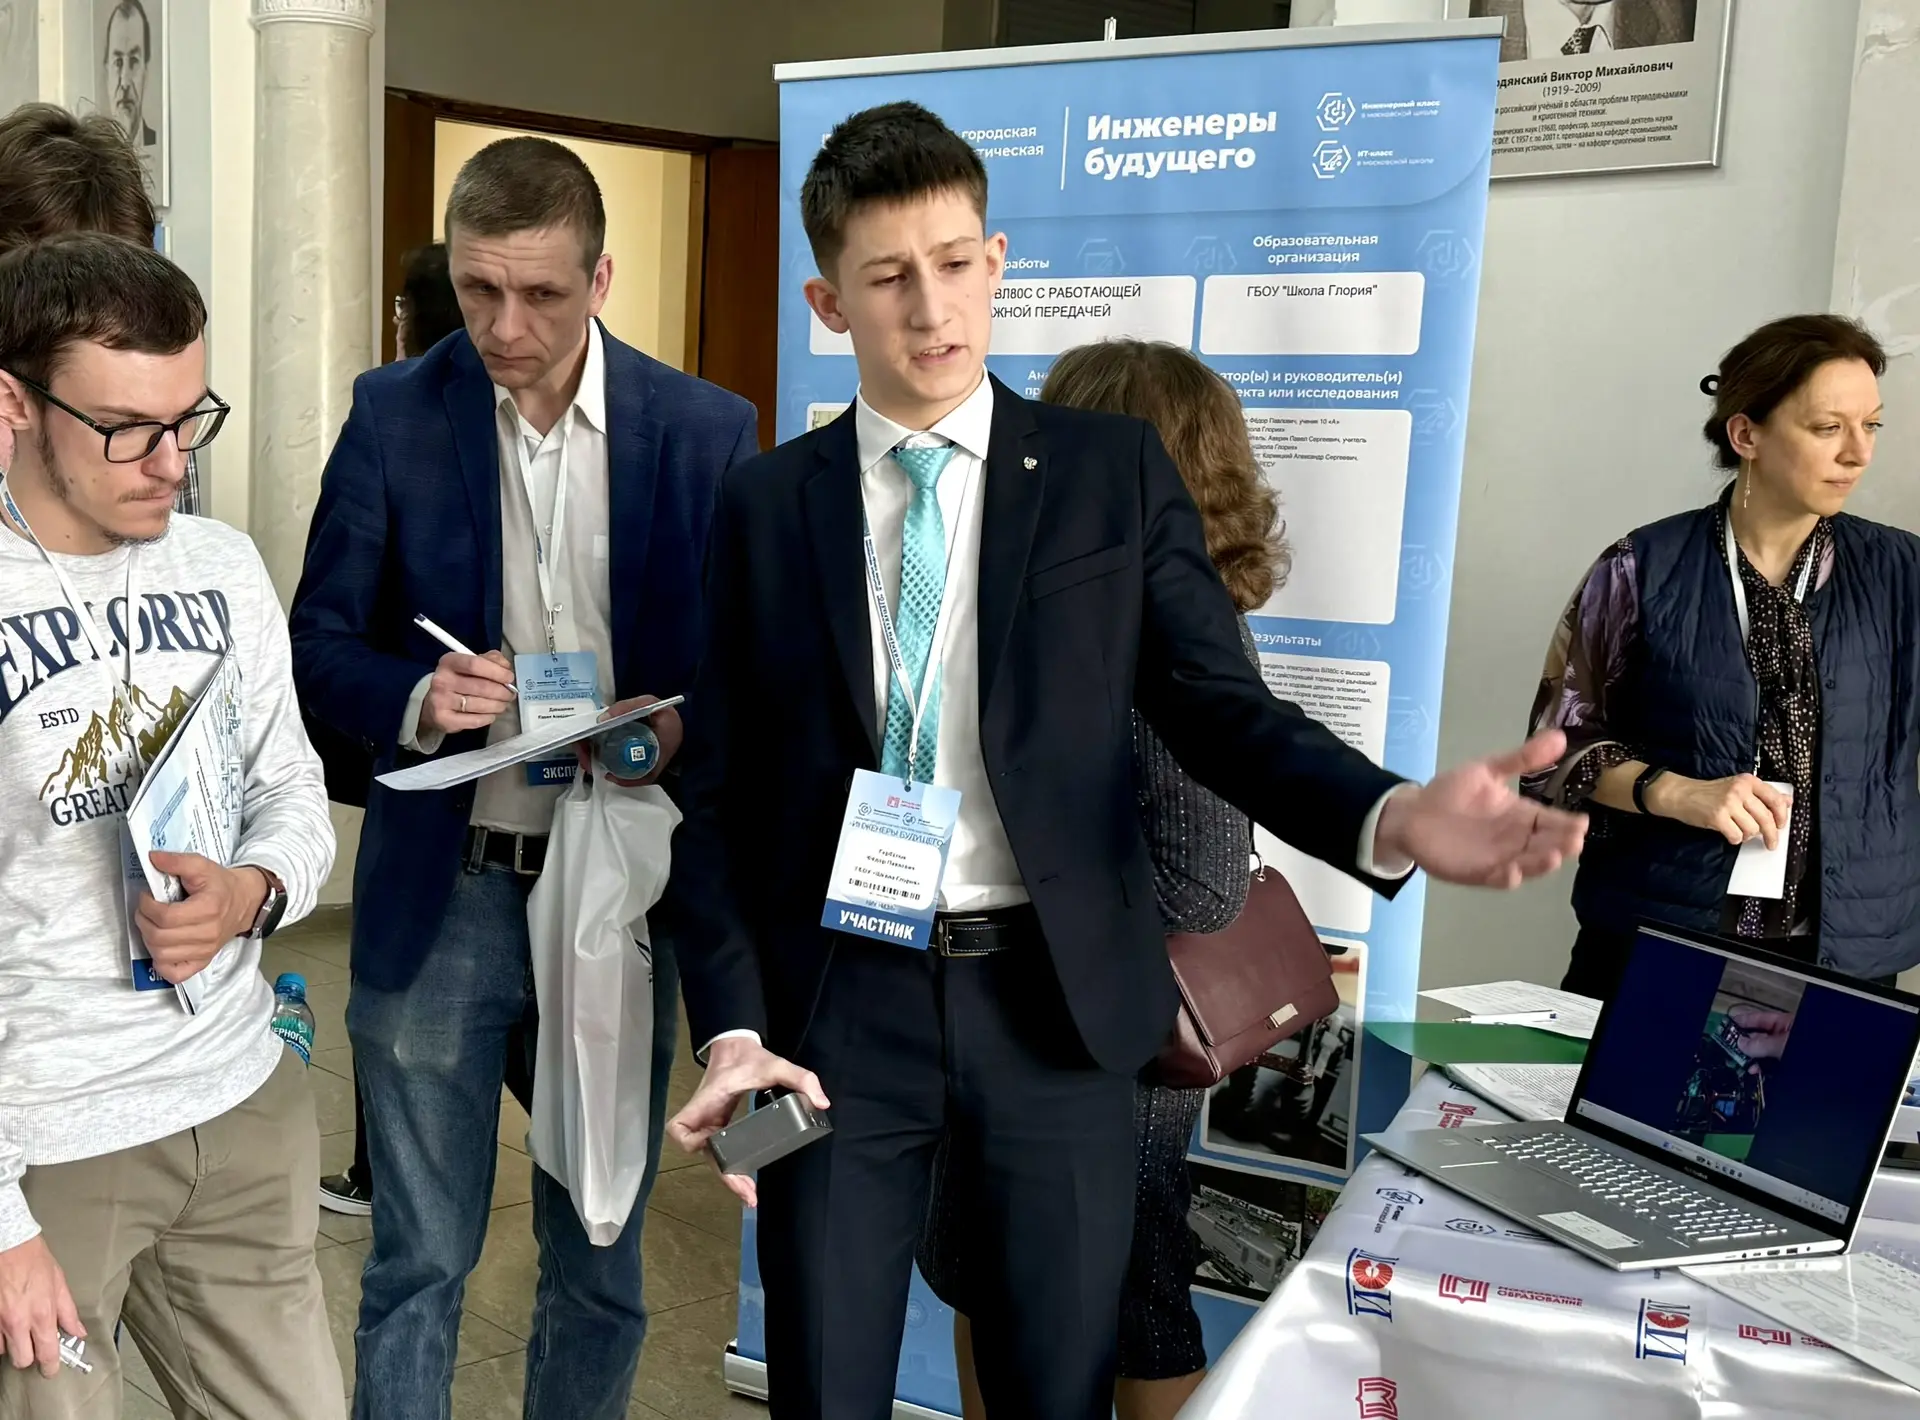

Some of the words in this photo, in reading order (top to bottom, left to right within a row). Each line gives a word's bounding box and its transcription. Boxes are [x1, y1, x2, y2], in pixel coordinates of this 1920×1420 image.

[1550, 68, 1593, 82] Виктор
[1595, 61, 1673, 77] Михайлович
[1362, 100, 1415, 110] Инженерный
[1500, 103, 1537, 115] российский
[1570, 98, 1597, 108] области
[1598, 94, 1629, 106] проблем
[1630, 90, 1688, 103] термодинамики
[1538, 109, 1577, 121] криогенной
[1086, 110, 1278, 142] Инженеры
[961, 126, 1037, 143] городская
[975, 144, 1045, 158] тическая
[1084, 146, 1256, 181] будущего
[1253, 234, 1379, 249] Образовательная
[1003, 257, 1049, 271] работы
[1268, 252, 1360, 266] организация
[1036, 287, 1045, 299] С
[1048, 283, 1141, 300] РАБОТАЮЩЕЙ
[1247, 285, 1279, 297] ГБОУ
[1282, 285, 1325, 297] "Школа
[1328, 284, 1377, 298] Глория"
[1034, 303, 1111, 319] ПЕРЕДАЧЕЙ
[1272, 372, 1281, 381] и
[1284, 370, 1402, 385] руководитель(и)
[1236, 387, 1265, 398] екта
[1268, 387, 1294, 398] или
[1297, 387, 1399, 400] исследования
[1252, 631, 1321, 647] езультаты
[38, 707, 80, 729] ESTD
[50, 783, 130, 826] GREAT
[839, 909, 915, 941] УЧАСТНИК
